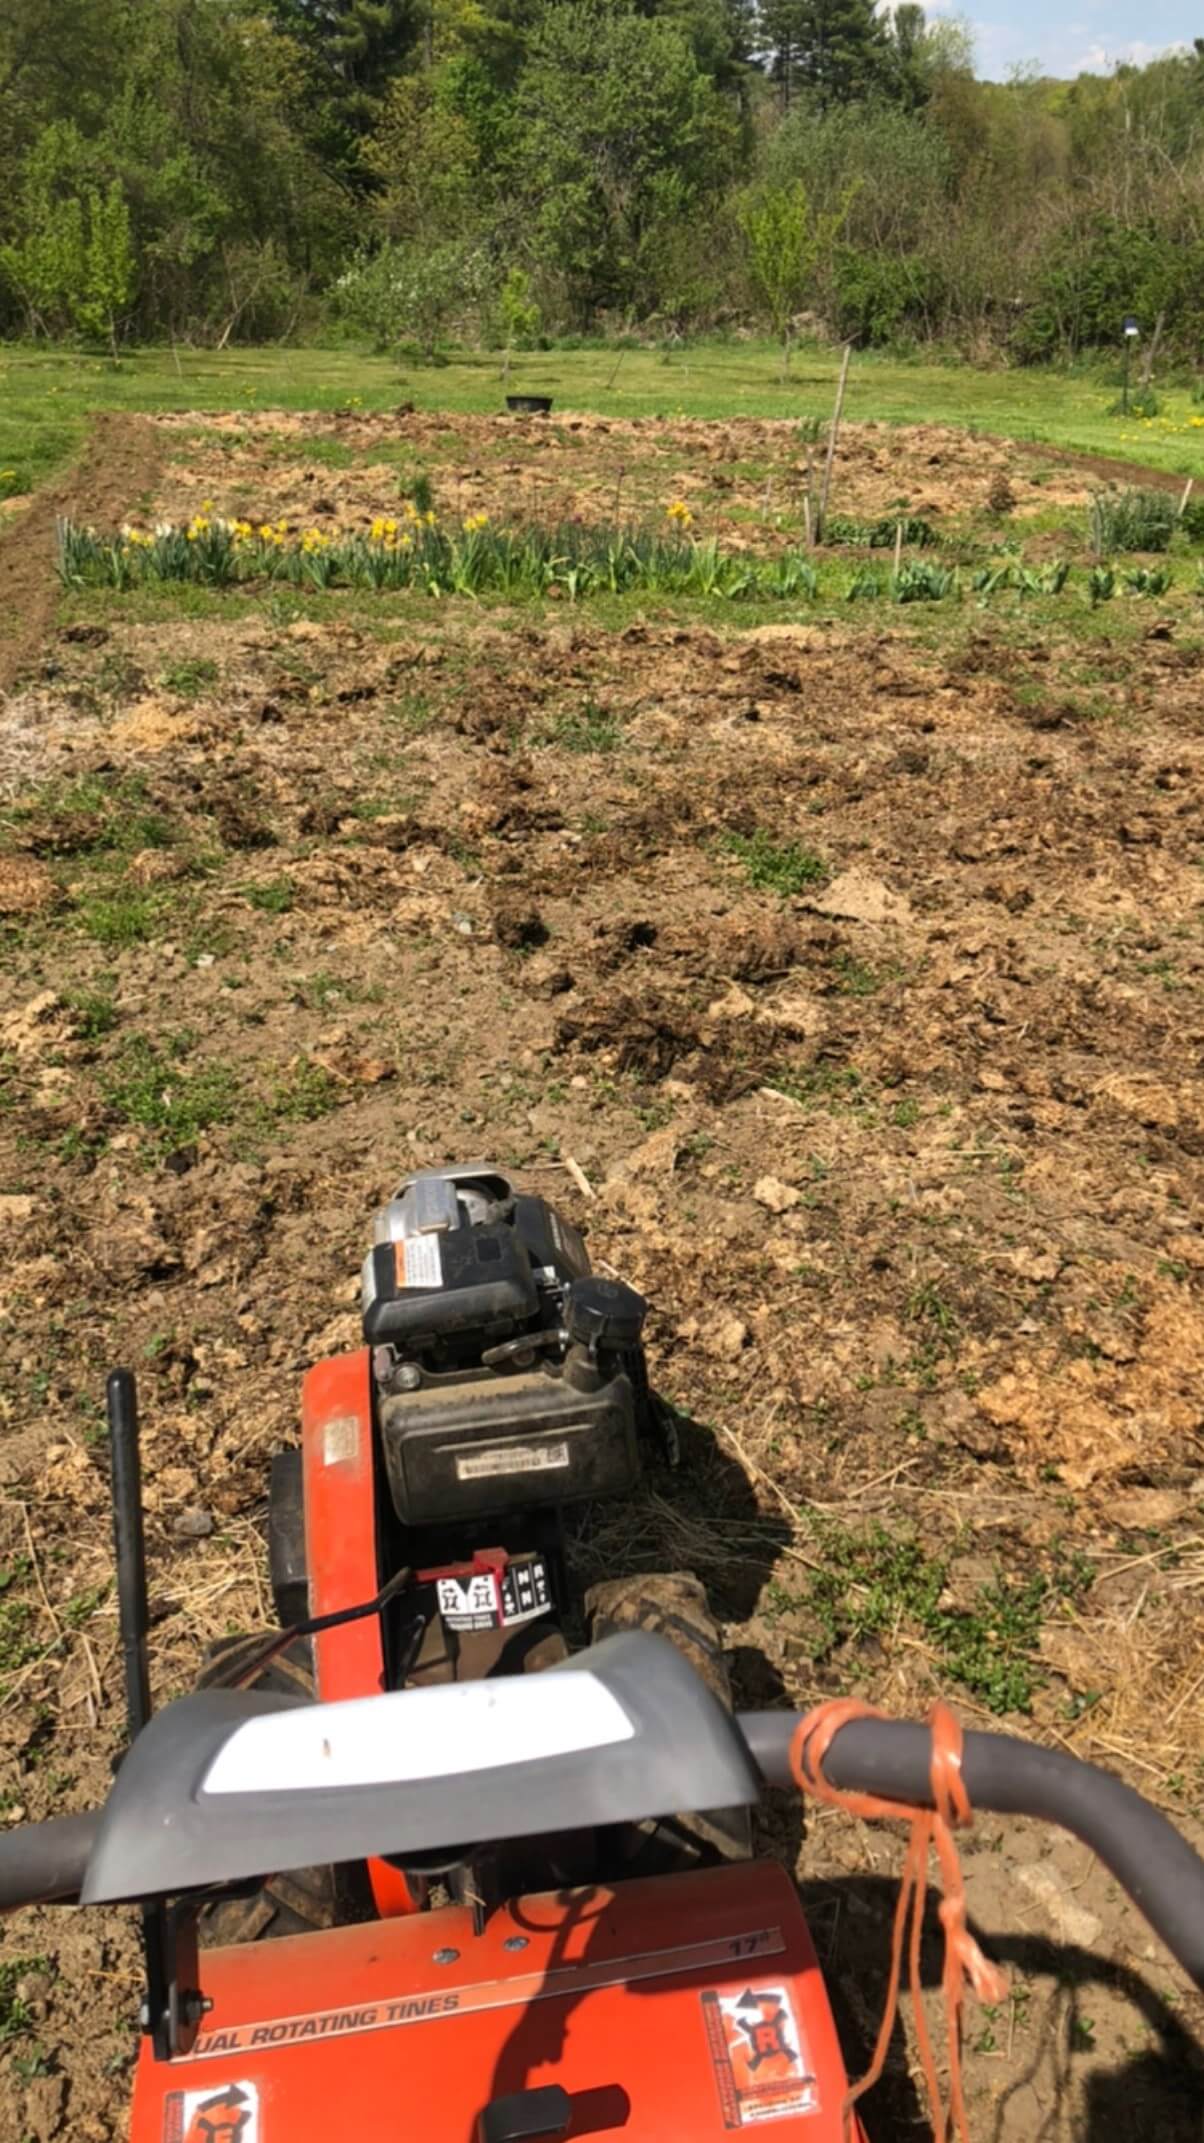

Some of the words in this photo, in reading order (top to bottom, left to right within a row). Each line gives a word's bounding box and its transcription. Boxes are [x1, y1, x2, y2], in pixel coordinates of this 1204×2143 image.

[193, 2031, 242, 2055] UAL
[250, 2008, 377, 2046] ROTATING
[386, 1993, 460, 2022] TINES
[756, 2027, 780, 2053] R
